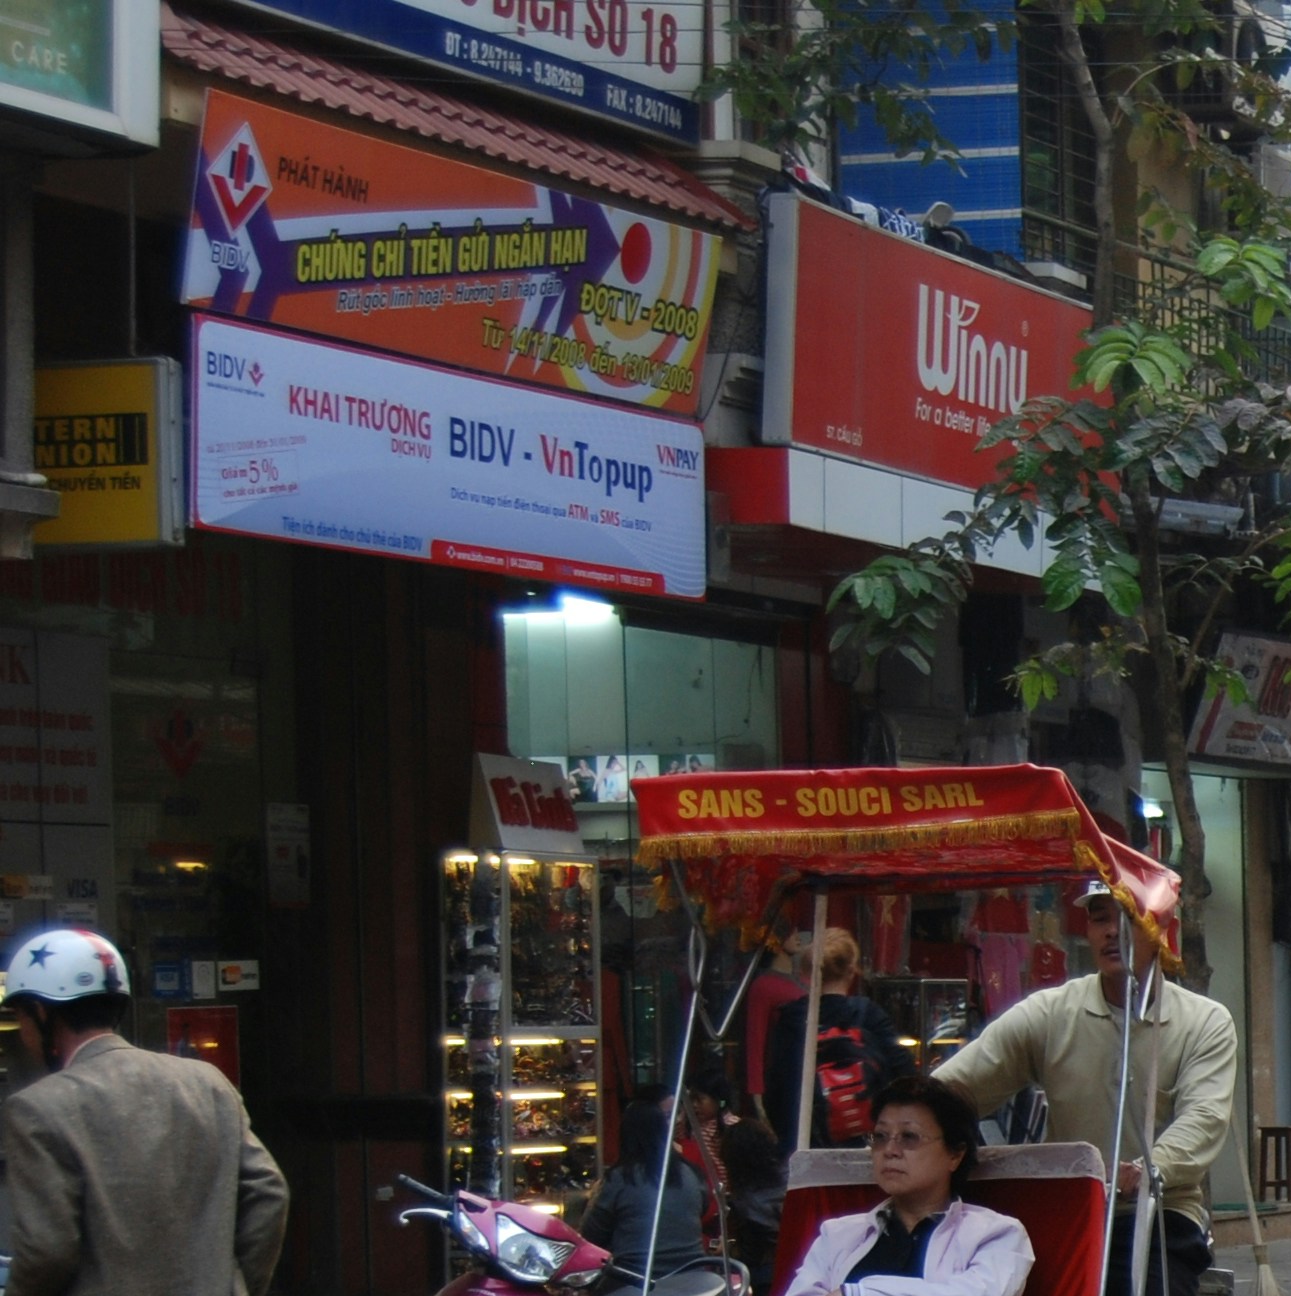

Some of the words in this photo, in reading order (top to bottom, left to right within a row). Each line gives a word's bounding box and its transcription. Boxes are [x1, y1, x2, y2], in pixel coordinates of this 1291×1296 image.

[11, 41, 68, 75] CARE
[641, 8, 678, 75] 18
[606, 84, 628, 113] FAX
[634, 94, 682, 130] 8.247144
[277, 156, 320, 189] PHÁT
[322, 165, 369, 203] HÀNH
[210, 239, 251, 272] BIDV
[297, 228, 366, 283] CHỨNG
[371, 222, 408, 278] CHỈ
[411, 220, 453, 275] TIỀN
[458, 217, 490, 271] GỬI
[494, 217, 545, 270] NGẮN
[551, 228, 587, 271] HẠN
[580, 282, 622, 325] ĐỢT
[651, 302, 698, 341] 2008
[206, 351, 246, 381] BIDV
[482, 318, 504, 348] Từ
[509, 327, 586, 369] 14/11/2008
[590, 341, 616, 376] đến
[621, 352, 694, 396] 13/01/2009
[916, 283, 1028, 416] Winny
[35, 416, 117, 441] TERN
[288, 384, 340, 423] KHAI
[344, 395, 432, 440] TRƯƠNG
[915, 397, 932, 425] For
[934, 408, 942, 425] a
[944, 406, 975, 435] better
[35, 442, 117, 467] NION
[391, 437, 416, 458] DỊCH
[449, 416, 515, 467] BIDV
[539, 433, 653, 503] VnTopup
[656, 444, 700, 471] VNPAY
[568, 503, 589, 522] ATM
[599, 508, 620, 528] SMS
[677, 788, 765, 819] SANS
[796, 786, 892, 816] SOUCI
[900, 782, 984, 812] SARL
[66, 879, 98, 898] VISA
